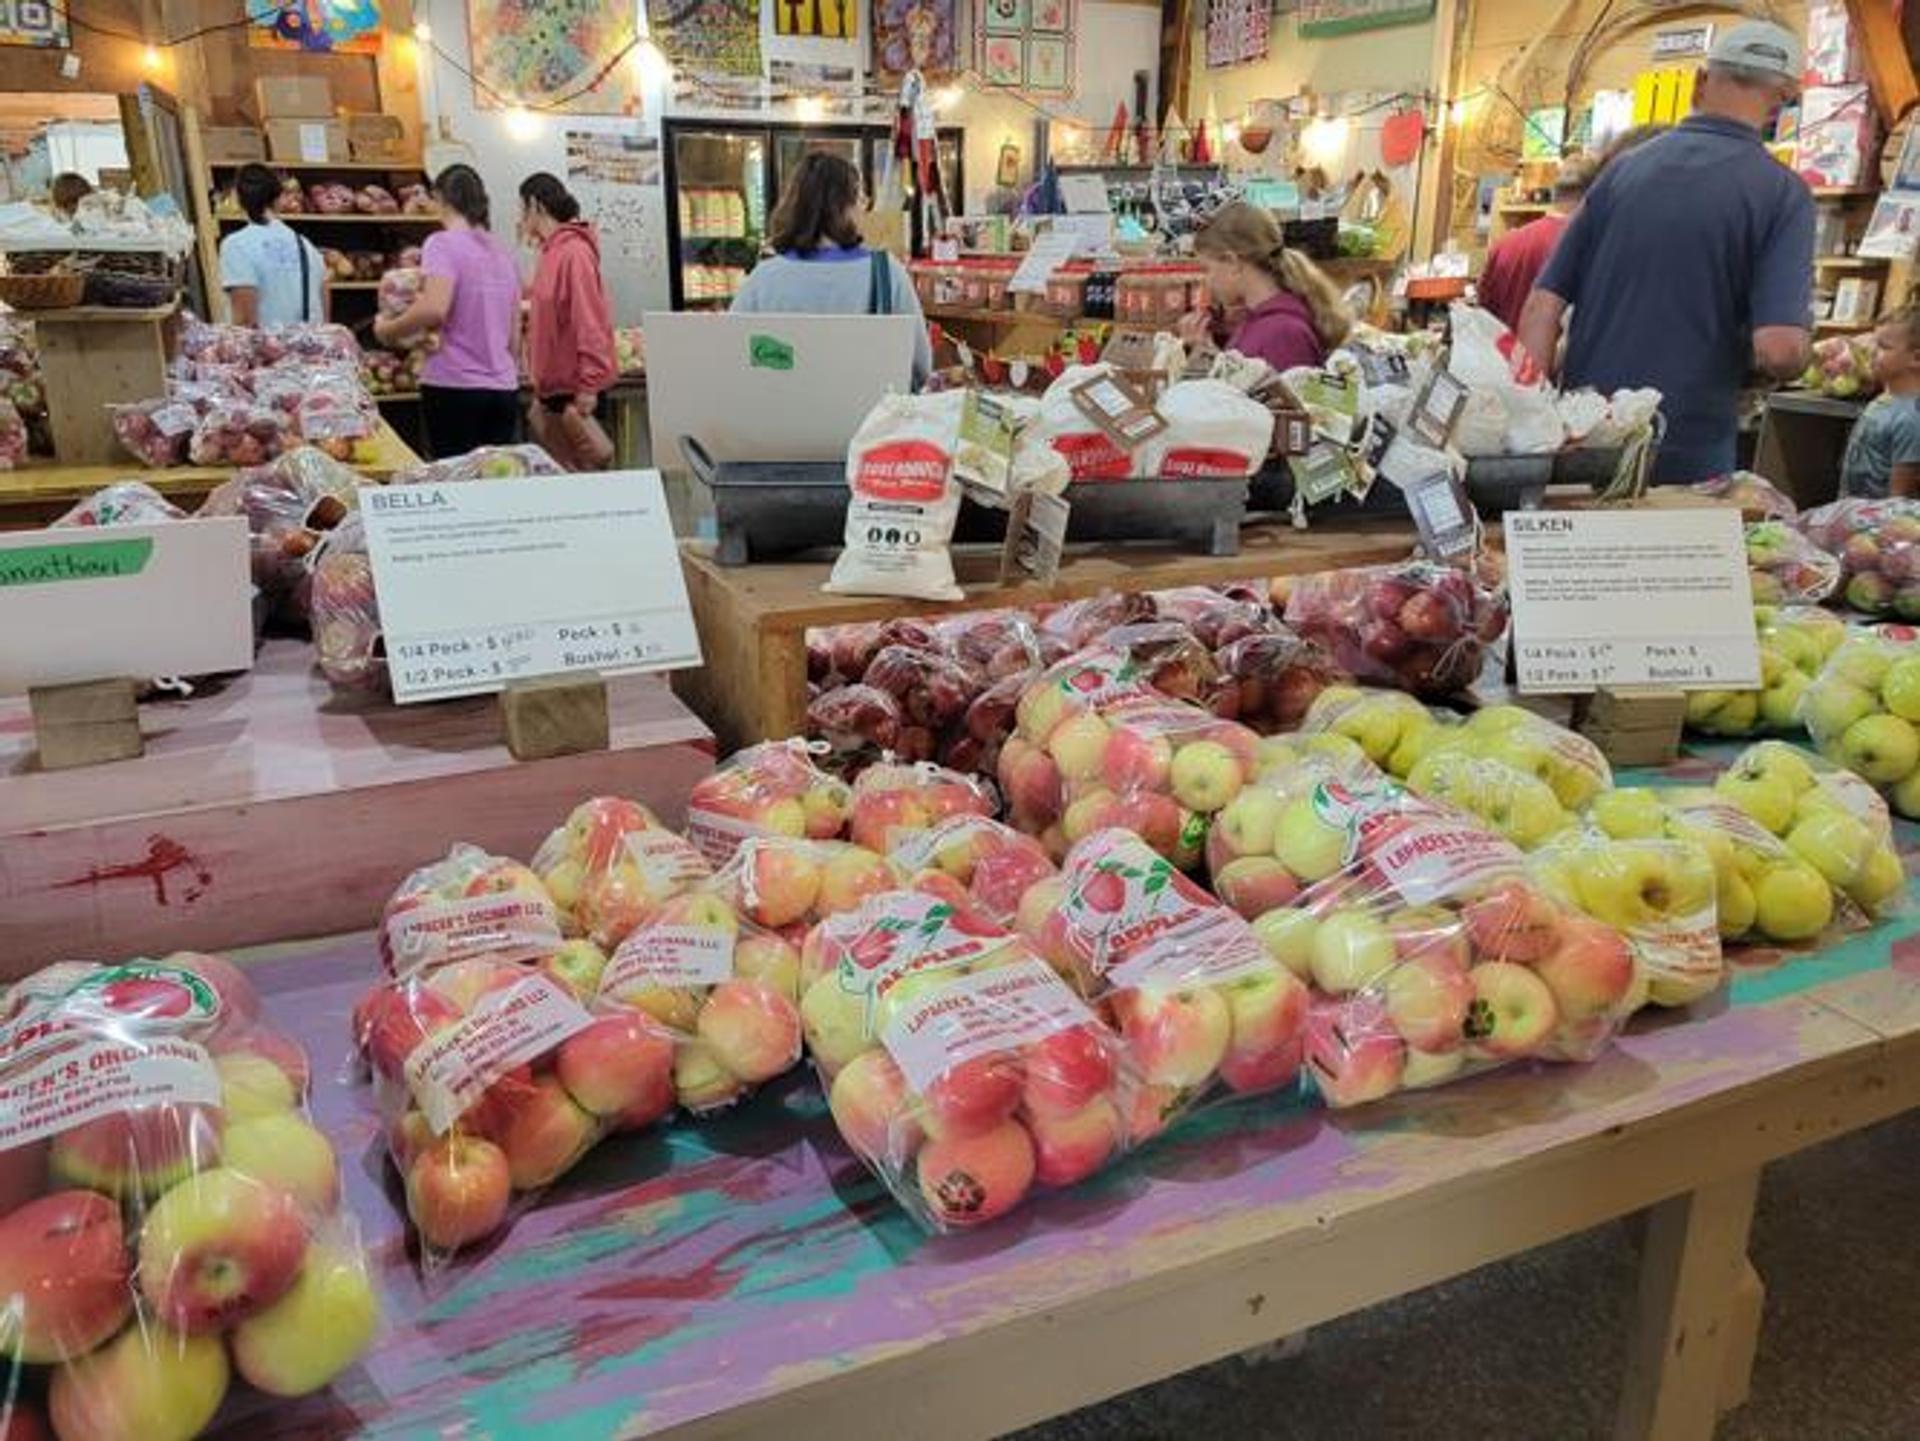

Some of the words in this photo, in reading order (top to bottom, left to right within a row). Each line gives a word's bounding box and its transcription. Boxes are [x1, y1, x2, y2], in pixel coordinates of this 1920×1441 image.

[371, 490, 448, 510] BELLA
[1512, 518, 1573, 532] SILKEN
[429, 639, 471, 656] Peck
[404, 670, 428, 684] 1/2
